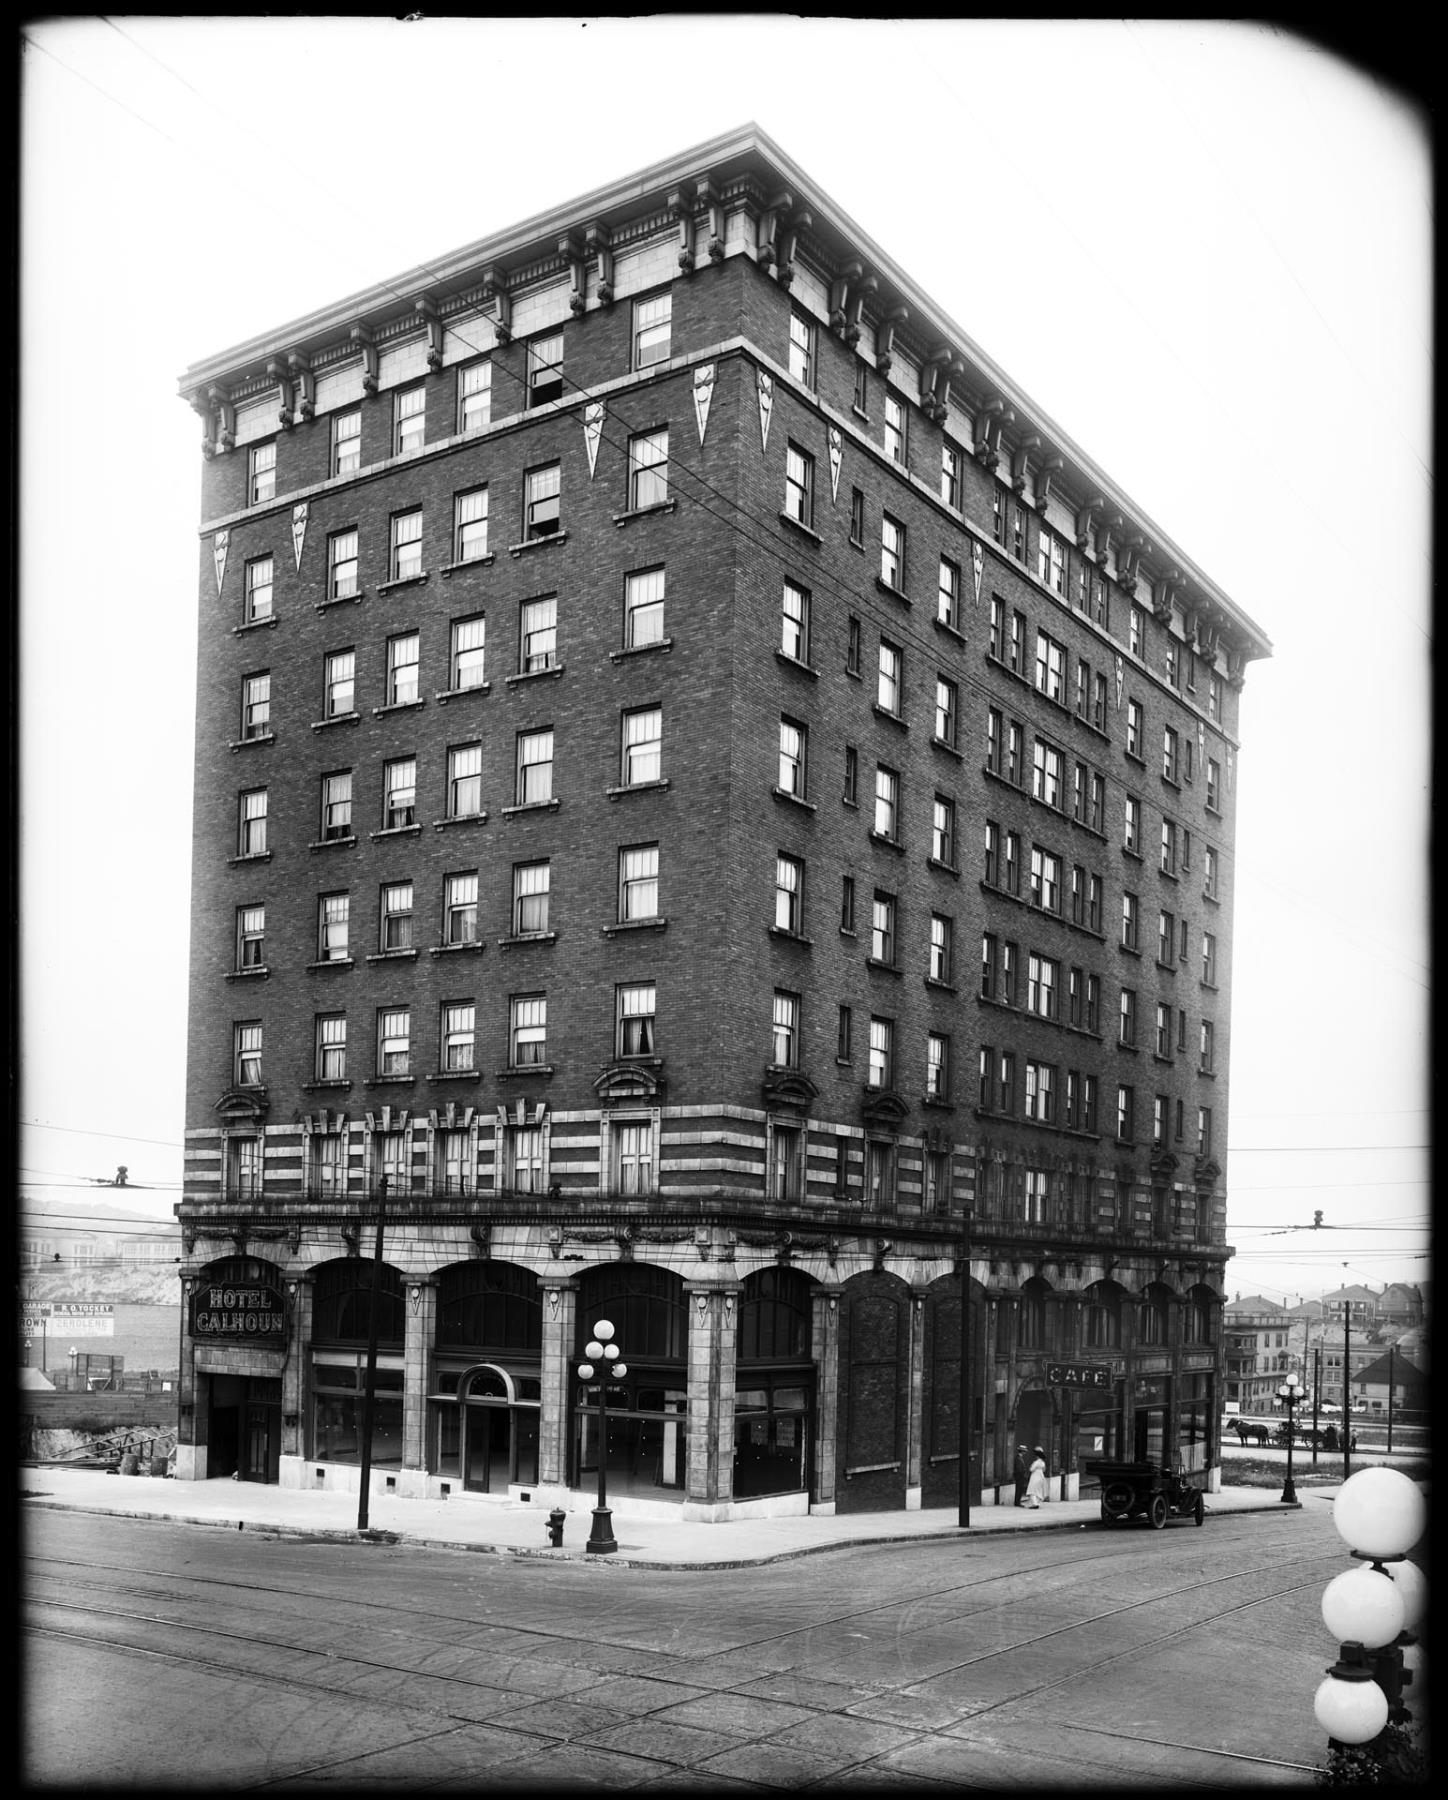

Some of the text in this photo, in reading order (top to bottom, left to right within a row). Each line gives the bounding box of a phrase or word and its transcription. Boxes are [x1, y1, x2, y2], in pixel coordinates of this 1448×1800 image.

[209, 1289, 272, 1309] HOTEL
[197, 1312, 283, 1332] CALHOUN
[1050, 1367, 1107, 1386] CAFE
